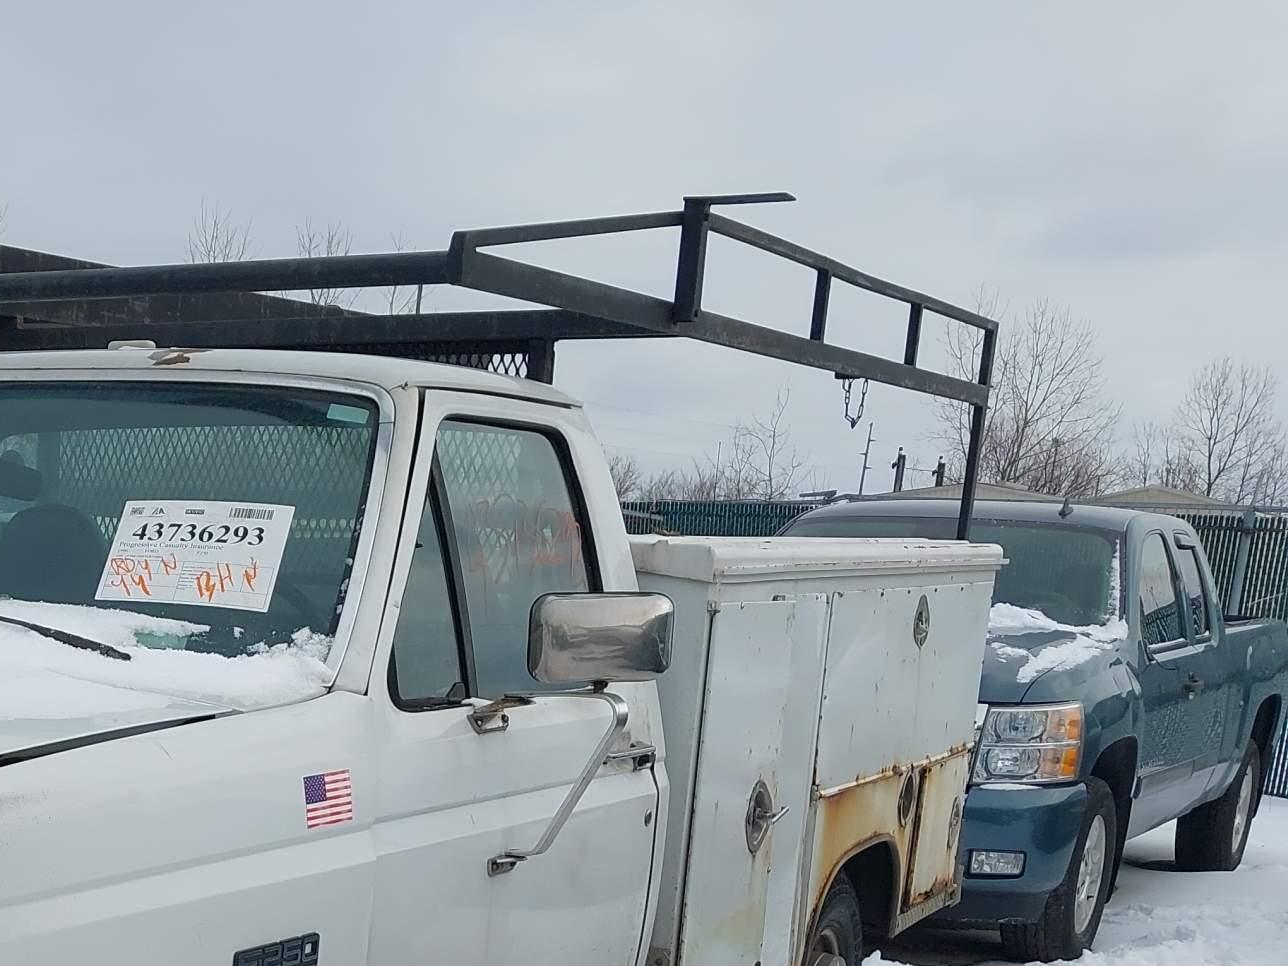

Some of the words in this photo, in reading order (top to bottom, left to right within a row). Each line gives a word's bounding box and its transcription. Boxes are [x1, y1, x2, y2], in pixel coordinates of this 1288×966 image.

[132, 522, 265, 546] 43736293
[119, 541, 158, 549] Progressive
[190, 543, 224, 551] Insurance
